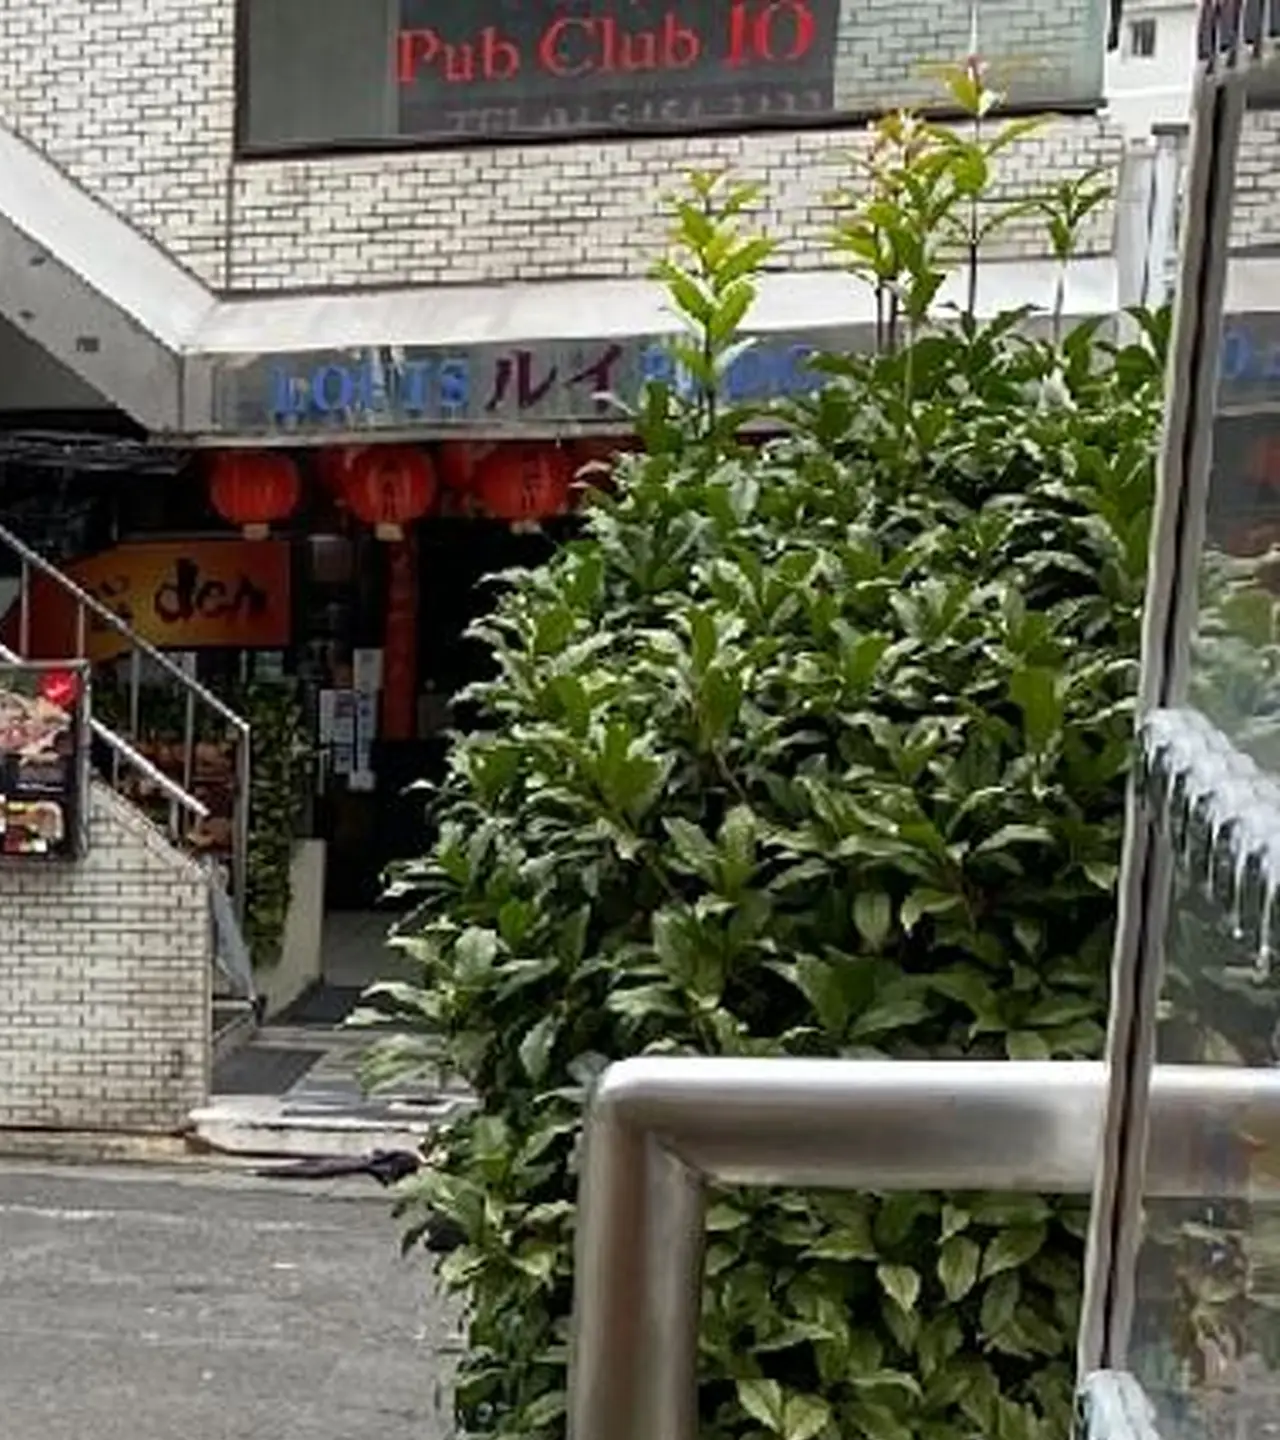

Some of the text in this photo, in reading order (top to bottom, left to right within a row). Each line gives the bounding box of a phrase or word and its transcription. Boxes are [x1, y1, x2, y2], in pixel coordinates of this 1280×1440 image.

[396, 26, 521, 83] Pub
[539, 12, 701, 77] Club
[485, 343, 624, 412] ルイ
